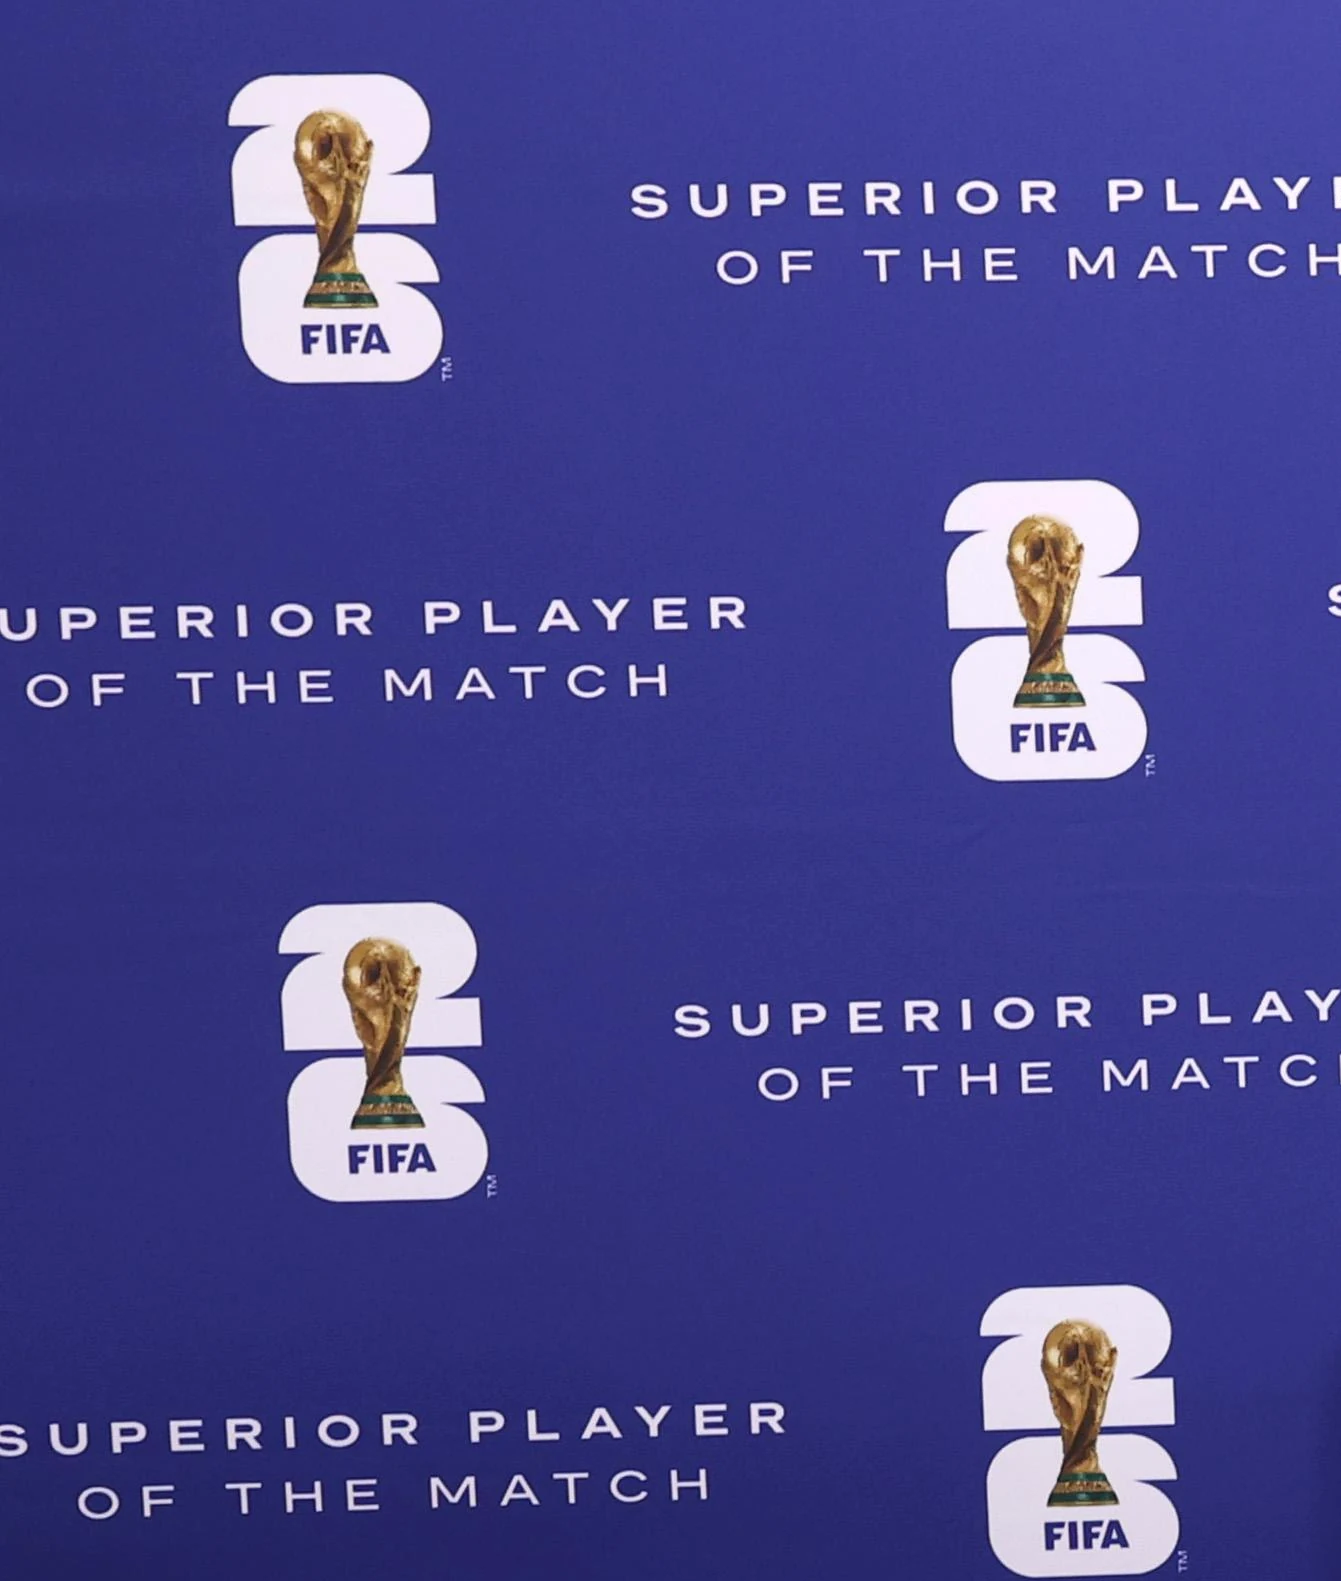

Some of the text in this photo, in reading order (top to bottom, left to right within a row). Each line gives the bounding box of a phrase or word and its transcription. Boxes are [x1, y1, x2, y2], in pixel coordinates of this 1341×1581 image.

[630, 179, 1057, 219] SUPERIOR
[716, 249, 814, 286] OF
[862, 247, 1019, 283] THE
[300, 323, 391, 355] FIFA
[0, 596, 747, 642] UPERIOR PLAYER
[25, 663, 668, 708] OF THE MATCH
[1010, 722, 1097, 753] FIFA
[673, 995, 1092, 1039] SUPERIOR
[757, 1066, 854, 1102] OF
[901, 1061, 1054, 1097] THE
[347, 1143, 437, 1175] FIFA
[0, 1401, 786, 1458] SUPERIOR PLAYER
[77, 1467, 708, 1520] OF THE MATCH
[1044, 1519, 1130, 1551] FIFA
